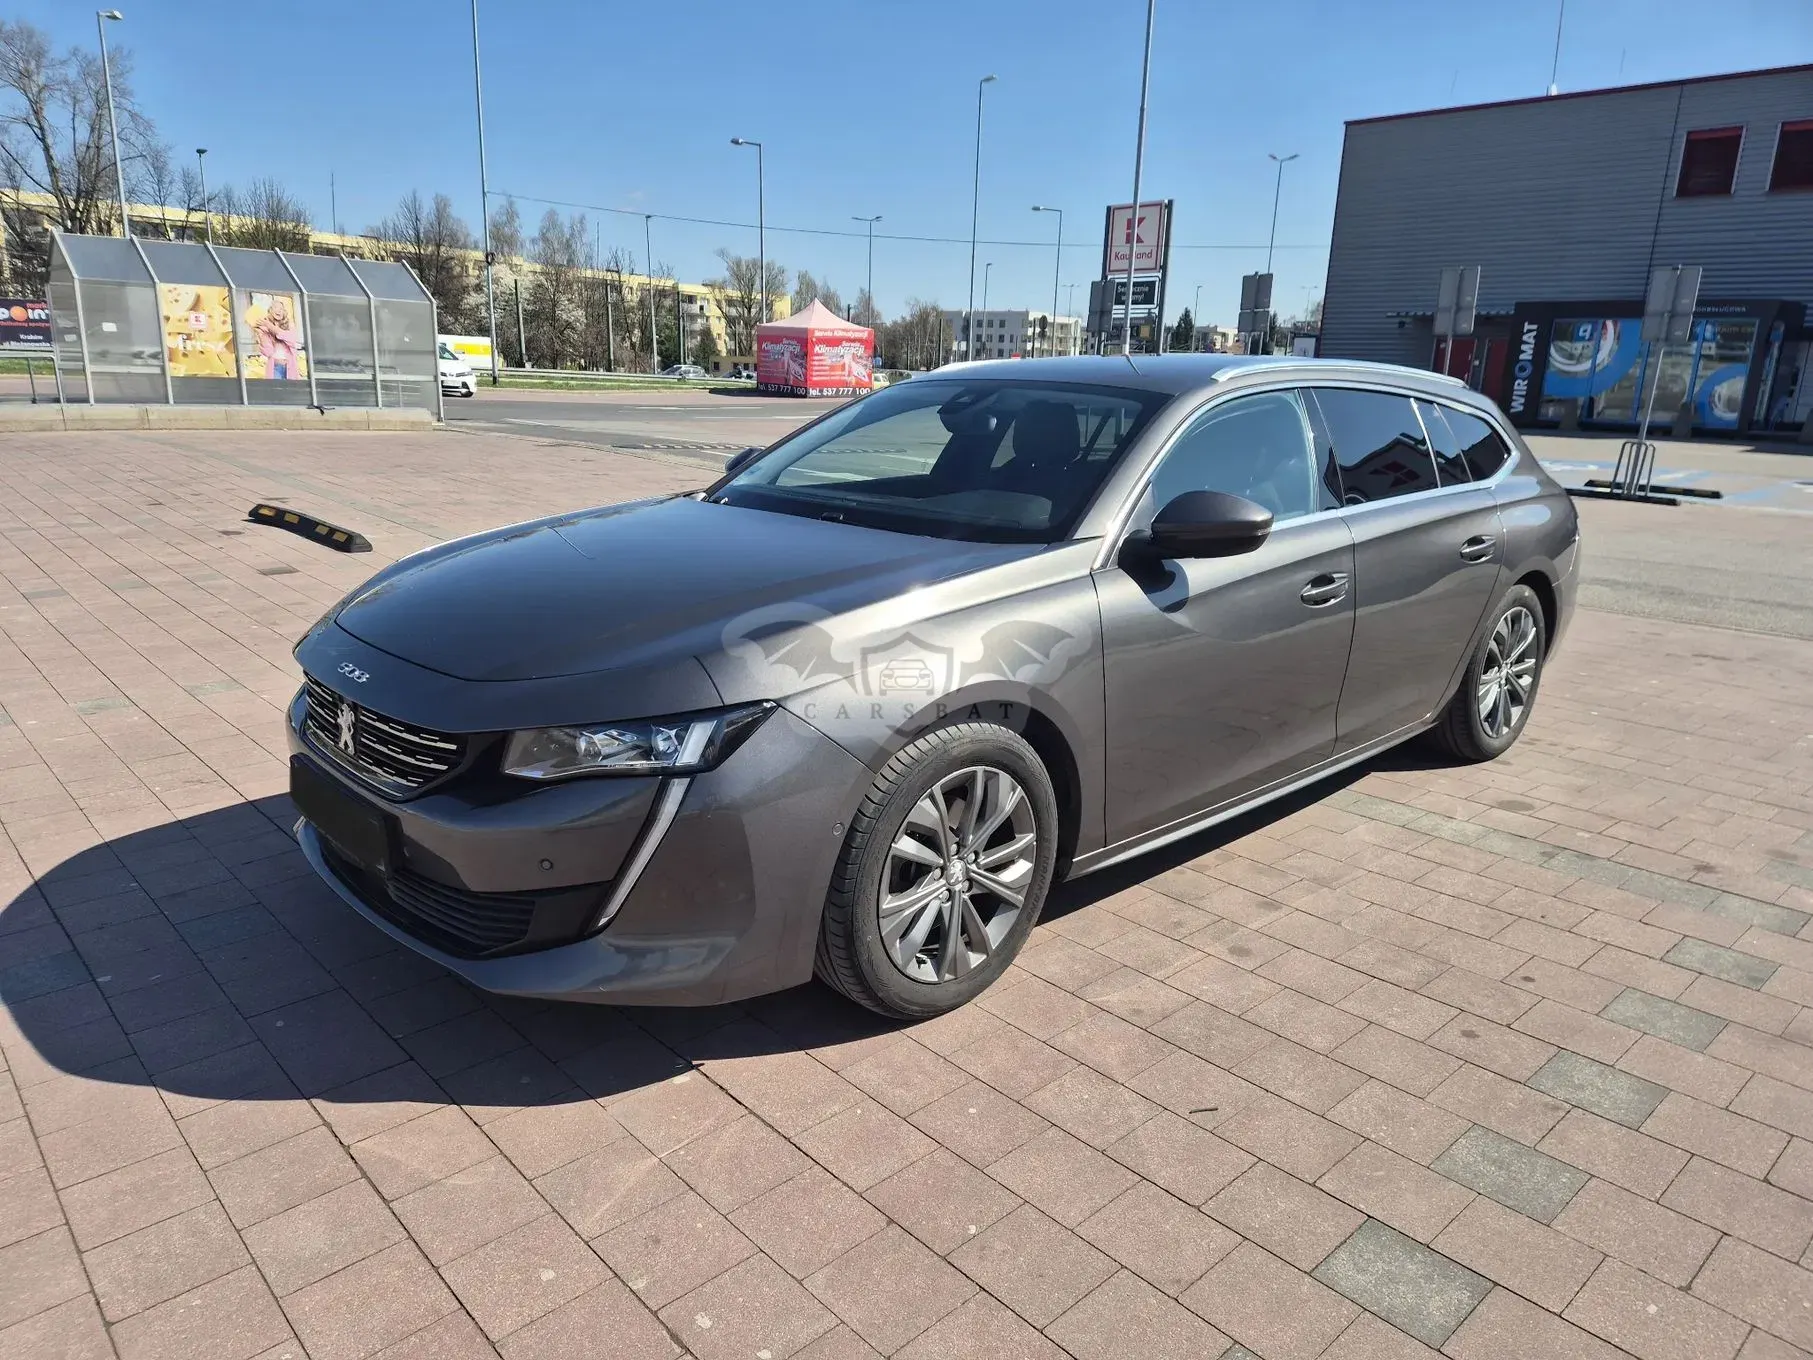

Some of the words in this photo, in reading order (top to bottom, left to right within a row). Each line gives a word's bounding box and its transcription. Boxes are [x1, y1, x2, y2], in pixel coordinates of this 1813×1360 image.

[762, 341, 800, 354] Klimatyzacji
[814, 344, 865, 355] Klimatyzacji
[1510, 321, 1538, 413] WIROMAT
[768, 383, 778, 391] 537
[780, 385, 792, 393] 777
[793, 386, 806, 395] 100
[809, 387, 822, 396] tel.
[823, 387, 837, 396] 537
[838, 387, 853, 395] 777
[856, 387, 871, 395] 100
[337, 662, 370, 683] 508
